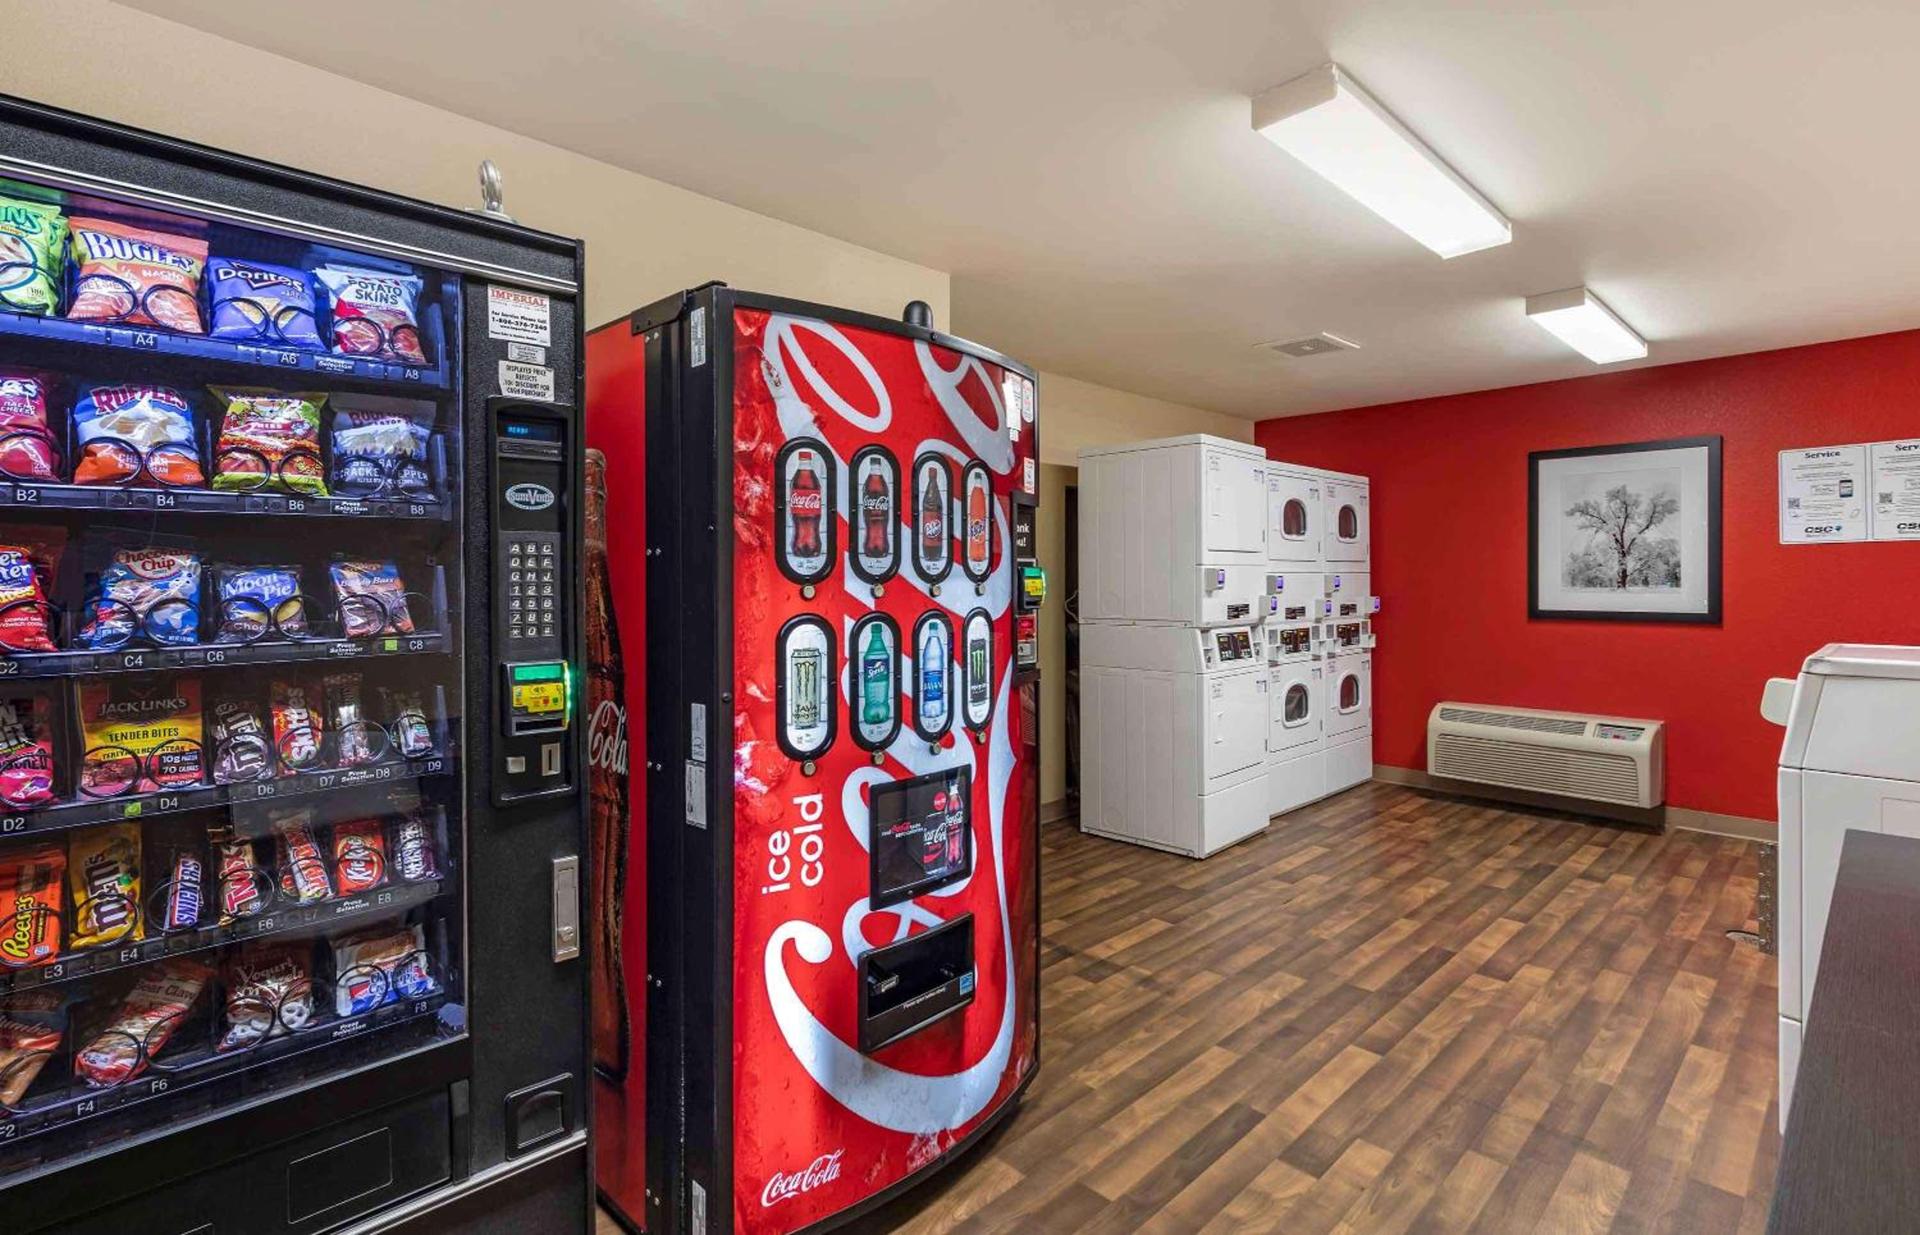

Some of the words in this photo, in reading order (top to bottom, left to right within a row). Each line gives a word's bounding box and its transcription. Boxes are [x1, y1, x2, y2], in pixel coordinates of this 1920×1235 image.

[80, 230, 195, 273] BUGLES
[218, 267, 305, 293] Doritos
[348, 279, 403, 296] POTATO
[356, 289, 399, 305] SKINS
[490, 288, 546, 307] IMPERIAL
[135, 333, 155, 347] A4
[280, 352, 299, 364] A6
[404, 368, 420, 380] A8
[1804, 450, 1841, 459] Service
[1895, 444, 1920, 452] Serv
[16, 490, 37, 502] B2
[156, 494, 175, 506] B4
[288, 500, 305, 511] B6
[410, 504, 425, 516] B8
[1804, 525, 1834, 534] CSC
[511, 544, 520, 552] A
[543, 544, 552, 552] C
[141, 557, 176, 572] Chip
[511, 558, 520, 566] D
[527, 558, 536, 566] E
[543, 558, 552, 566] F
[511, 573, 520, 581] G
[527, 573, 536, 581] H
[543, 573, 552, 581] J
[224, 572, 279, 596] Moon
[511, 586, 520, 594] 1
[527, 586, 536, 594] 2
[543, 586, 552, 594] 3
[264, 583, 292, 601] Pie
[511, 600, 520, 608] 4
[511, 614, 520, 622] 7
[527, 614, 536, 622] 8
[527, 628, 536, 636] 0
[409, 640, 424, 651] C8
[124, 654, 144, 668] C4
[206, 650, 225, 663] C6
[0, 662, 19, 675] C2
[101, 701, 140, 717] JACK
[794, 703, 818, 713] JAVA
[109, 730, 149, 744] TENDER
[151, 727, 180, 740] BITES
[163, 765, 176, 774] 70
[428, 760, 442, 772] D9
[375, 767, 391, 780] D8
[319, 775, 335, 787] D7
[257, 783, 275, 796] D6
[159, 797, 178, 810] D4
[3, 817, 25, 832] D2
[792, 792, 824, 888] cold
[761, 829, 791, 895] ice
[176, 858, 202, 926] SNICKERS
[377, 892, 392, 905] E8
[3, 894, 36, 959] Reese's
[257, 918, 274, 931] E6
[120, 948, 138, 962] E4
[44, 964, 63, 979] E3
[414, 1001, 428, 1014] F8
[151, 1079, 168, 1094] F6
[77, 1101, 94, 1116] F4
[0, 1124, 15, 1138] F2
[760, 1148, 844, 1208] Coca-Cola
